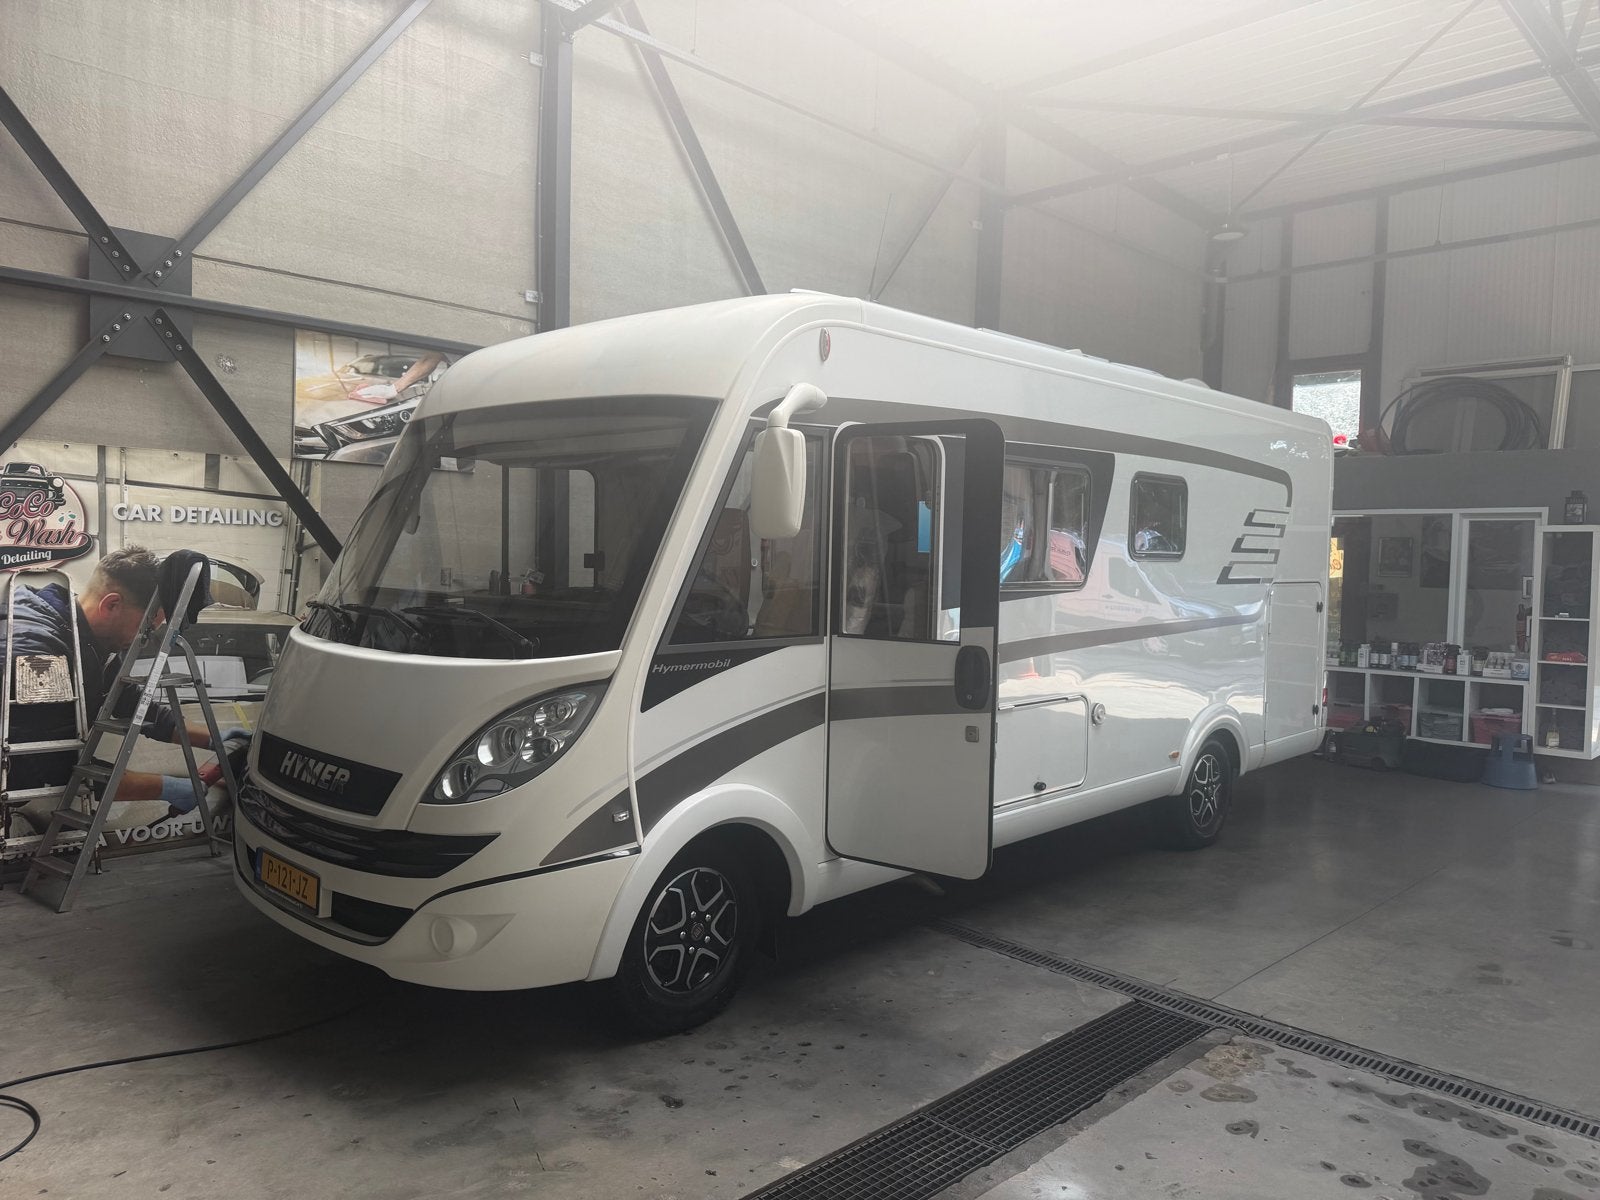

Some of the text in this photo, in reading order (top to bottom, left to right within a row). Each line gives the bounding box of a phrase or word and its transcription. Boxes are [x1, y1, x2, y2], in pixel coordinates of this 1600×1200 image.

[112, 503, 284, 527] CAR DETAILING
[6, 517, 80, 546] Wash
[1, 550, 52, 565] Detailing
[652, 659, 731, 674] Hymermobil
[279, 751, 351, 794] HYMER
[114, 822, 184, 845] VOOR
[266, 859, 309, 900] P-121-JZ
